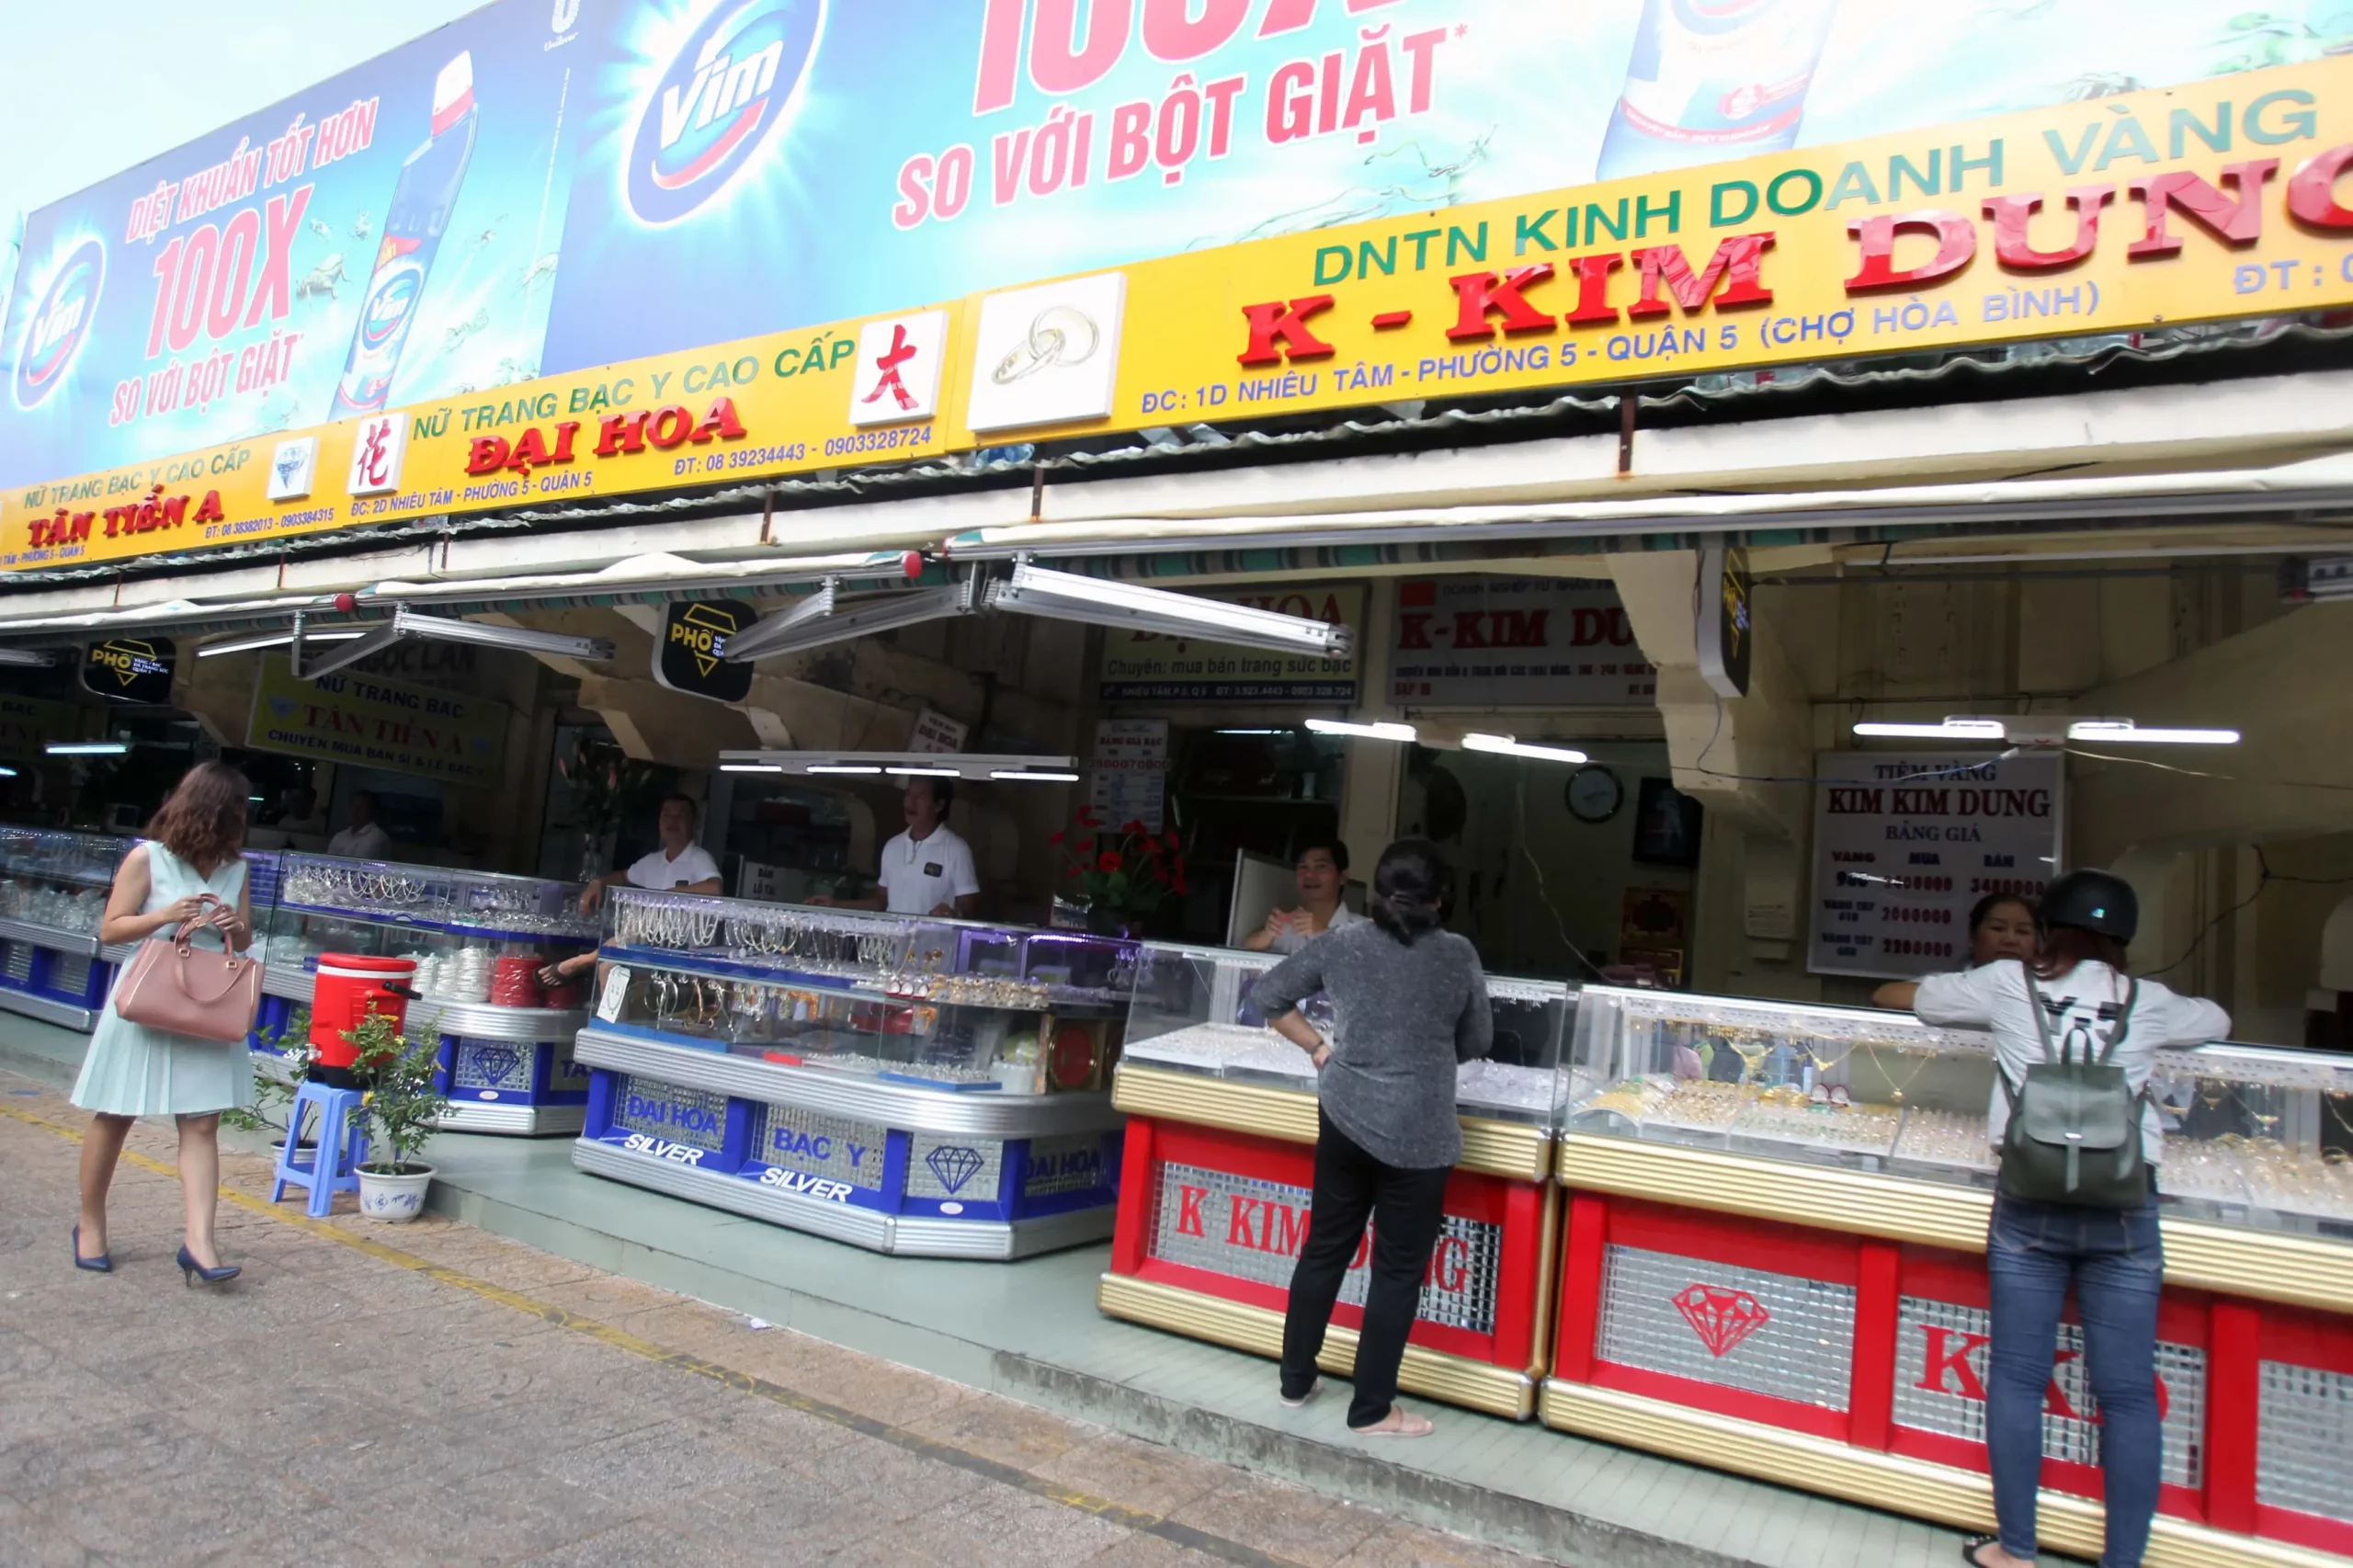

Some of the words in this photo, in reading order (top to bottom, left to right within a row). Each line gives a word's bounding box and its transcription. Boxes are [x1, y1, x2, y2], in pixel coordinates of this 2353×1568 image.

[659, 38, 784, 151] Vim
[125, 182, 178, 244] DIỆT
[264, 112, 315, 186] TỐT
[313, 96, 380, 172] HƠN
[892, 143, 973, 230] SO
[993, 101, 1094, 207] VỚI
[1106, 74, 1247, 187] BỘT
[1314, 219, 1489, 287] DNTN
[1515, 187, 1683, 256] KINH
[1711, 139, 2003, 228] DOANH
[2042, 88, 2318, 176] VÀNG
[145, 186, 314, 359] 100X
[1236, 293, 1336, 368] K
[1445, 230, 1777, 341] KIM
[33, 284, 85, 357] Vim
[1196, 384, 1228, 406] 1D
[1238, 370, 1317, 402] NHIÊU
[1333, 361, 1393, 392] TÂM
[1418, 342, 1551, 381] PHƯỜNG
[1560, 335, 1577, 367] 5
[1606, 324, 1707, 362] QUẬN
[1719, 323, 1739, 351] 5
[1760, 307, 1856, 348] (CHỢ
[1872, 293, 1959, 333] HÒA
[1983, 279, 2100, 324] BÌNH)
[108, 378, 142, 427] SO
[145, 353, 184, 415] VỚI
[185, 344, 234, 412] BỘT
[413, 405, 451, 441] NỮ
[461, 392, 558, 432] TRANG
[569, 377, 636, 417] BẠC
[653, 373, 680, 401] Y
[684, 356, 759, 393] CAO
[774, 330, 856, 379] CẤP
[860, 323, 919, 412] 大
[358, 417, 392, 488] 花
[466, 420, 577, 478] ĐẠI
[593, 395, 749, 459] HOA
[707, 452, 724, 471] 08
[729, 444, 805, 466] 39234443
[824, 426, 932, 457] 0903328724
[51, 478, 103, 505] TRANG
[108, 472, 142, 496] BẠC
[166, 458, 205, 483] CAO
[211, 445, 251, 475] CẤP
[430, 483, 454, 506] TÂM
[463, 475, 517, 502] PHƯỜNG
[521, 478, 530, 496] 5
[540, 472, 581, 494] QUẬN
[584, 470, 593, 487] 5
[28, 507, 96, 548] TÂN
[192, 490, 225, 524] A
[670, 622, 714, 652] PHỐ
[1397, 609, 1550, 650] K-KIM
[1571, 608, 1636, 646] DU
[1108, 658, 1167, 677] Chuyên:
[1172, 660, 1201, 674] mua
[1209, 656, 1236, 674] bán
[1242, 657, 1282, 676] trang
[1288, 653, 1316, 674] sức
[303, 704, 364, 737] TÂN
[354, 681, 420, 710] TRANG
[1828, 788, 1884, 814] KIM
[1891, 789, 1950, 815] KIM
[1958, 789, 2052, 818] DUNG
[1886, 820, 1940, 842] BẢNG
[624, 1133, 705, 1167] SILVER
[671, 1105, 720, 1138] HOA
[774, 1129, 832, 1163] BẠC
[847, 1142, 868, 1168] Y
[759, 1166, 854, 1203] SILVER
[1177, 1184, 1210, 1238] K
[1225, 1194, 1313, 1261] KIM
